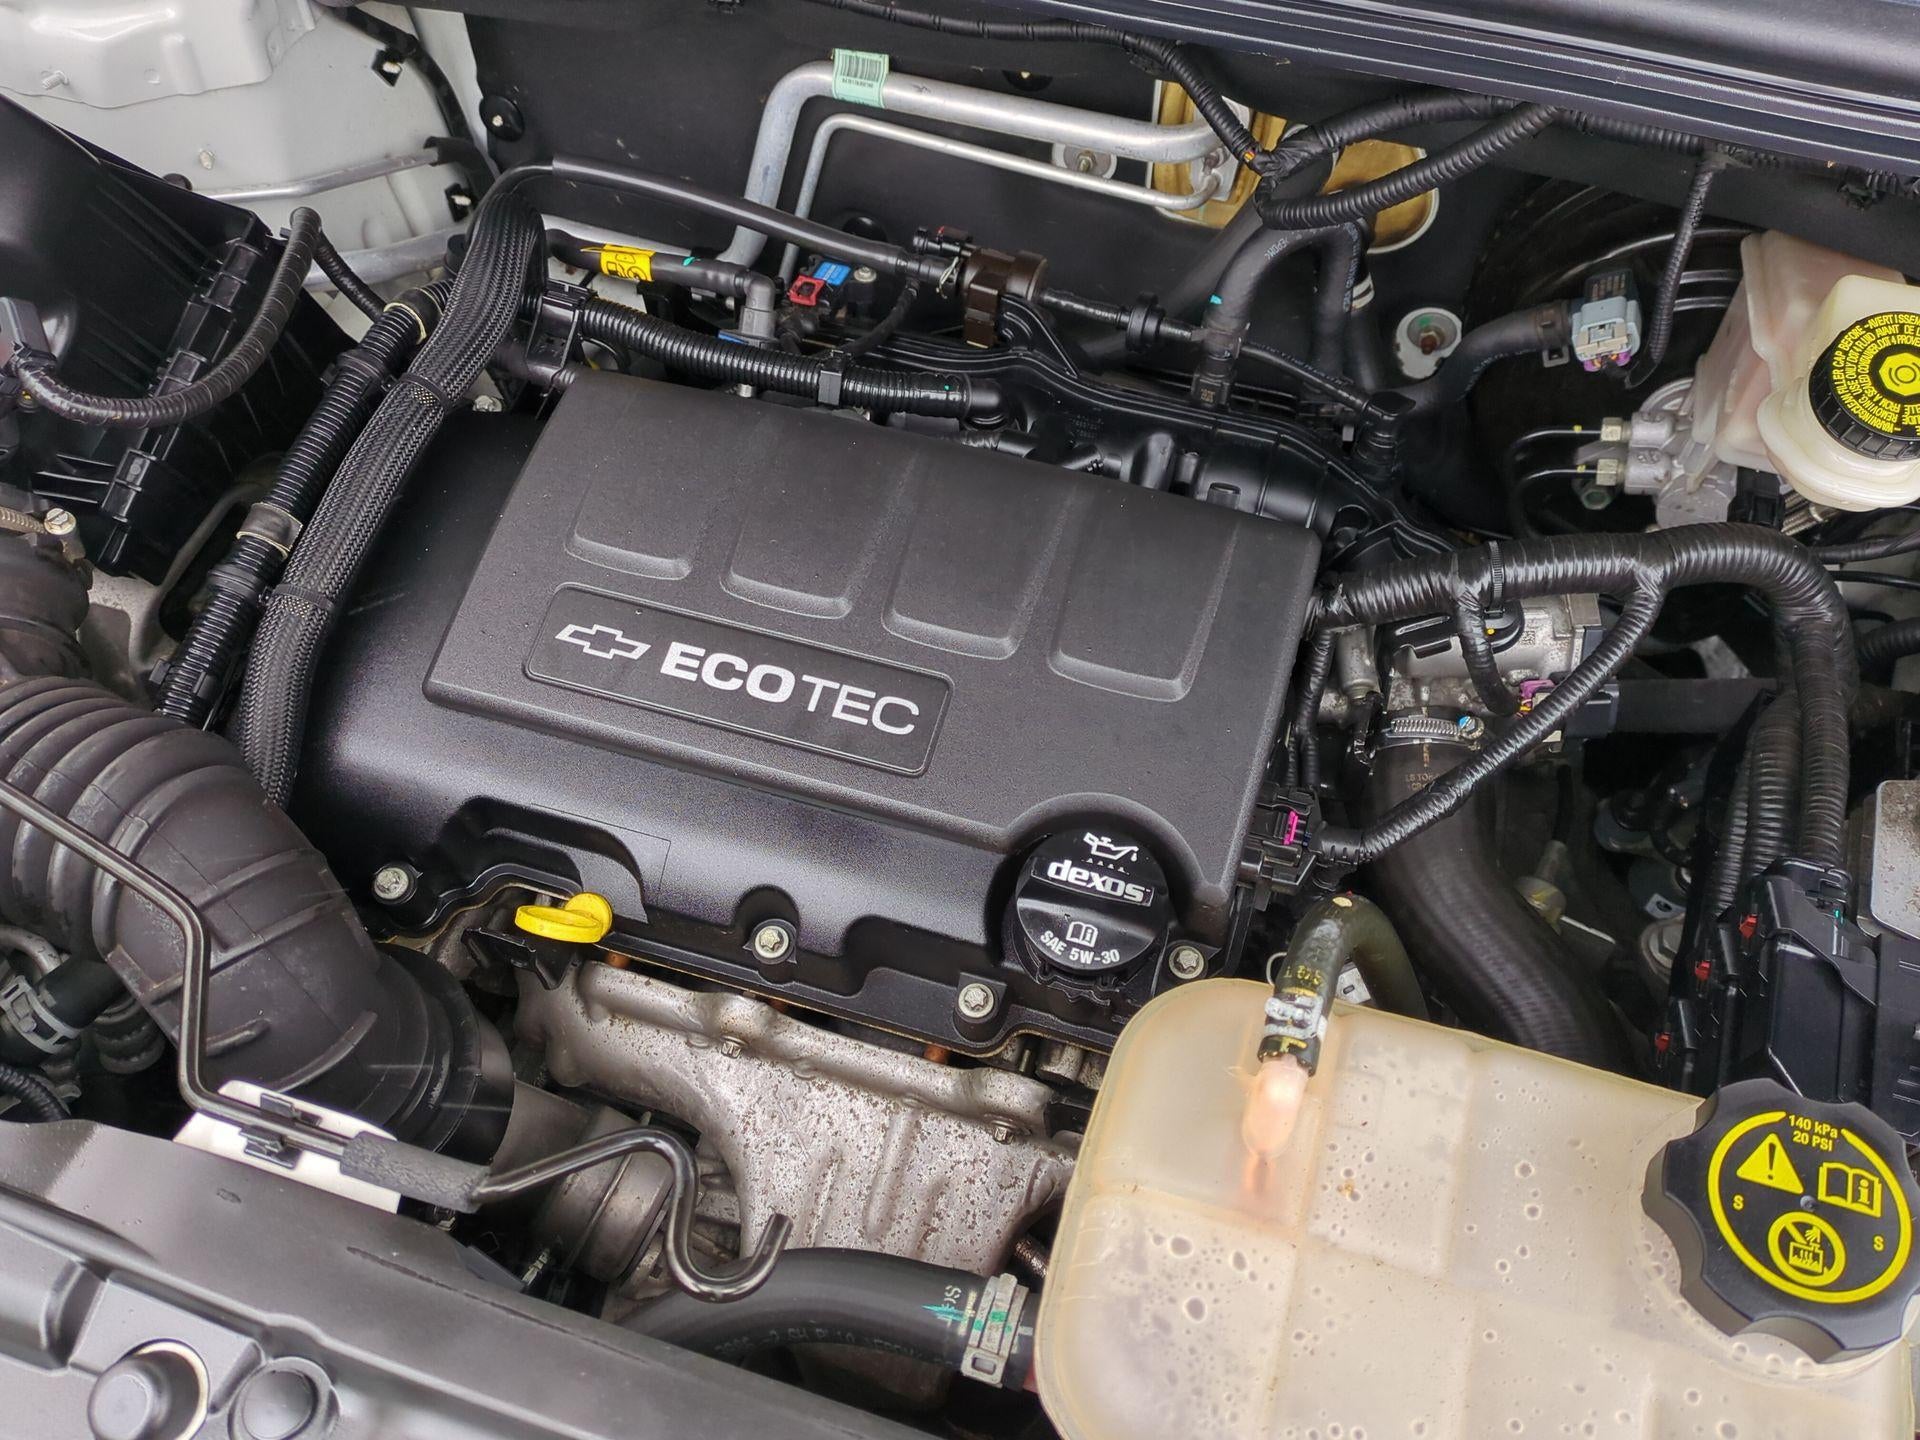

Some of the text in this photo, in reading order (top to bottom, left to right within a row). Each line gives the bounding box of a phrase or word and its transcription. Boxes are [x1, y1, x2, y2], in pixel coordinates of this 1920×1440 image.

[1838, 325, 1866, 351] BEFORE
[1875, 324, 1900, 338] AVANT
[1832, 350, 1846, 368] CAP
[1845, 361, 1857, 379] ONLY
[1832, 369, 1849, 395] FILLER
[1847, 379, 1863, 396] USE
[1858, 374, 1877, 397] SEALED
[1873, 393, 1883, 402] A
[1879, 397, 1901, 413] FROM
[660, 641, 920, 735] ECOTEC
[1047, 859, 1146, 903] dexos
[1040, 930, 1121, 965] SAE 5W-30
[1789, 1114, 1838, 1139] 140 kPa
[1793, 1130, 1833, 1152] 20 PSI
[1732, 1194, 1744, 1211] S
[1873, 1235, 1885, 1252] S
